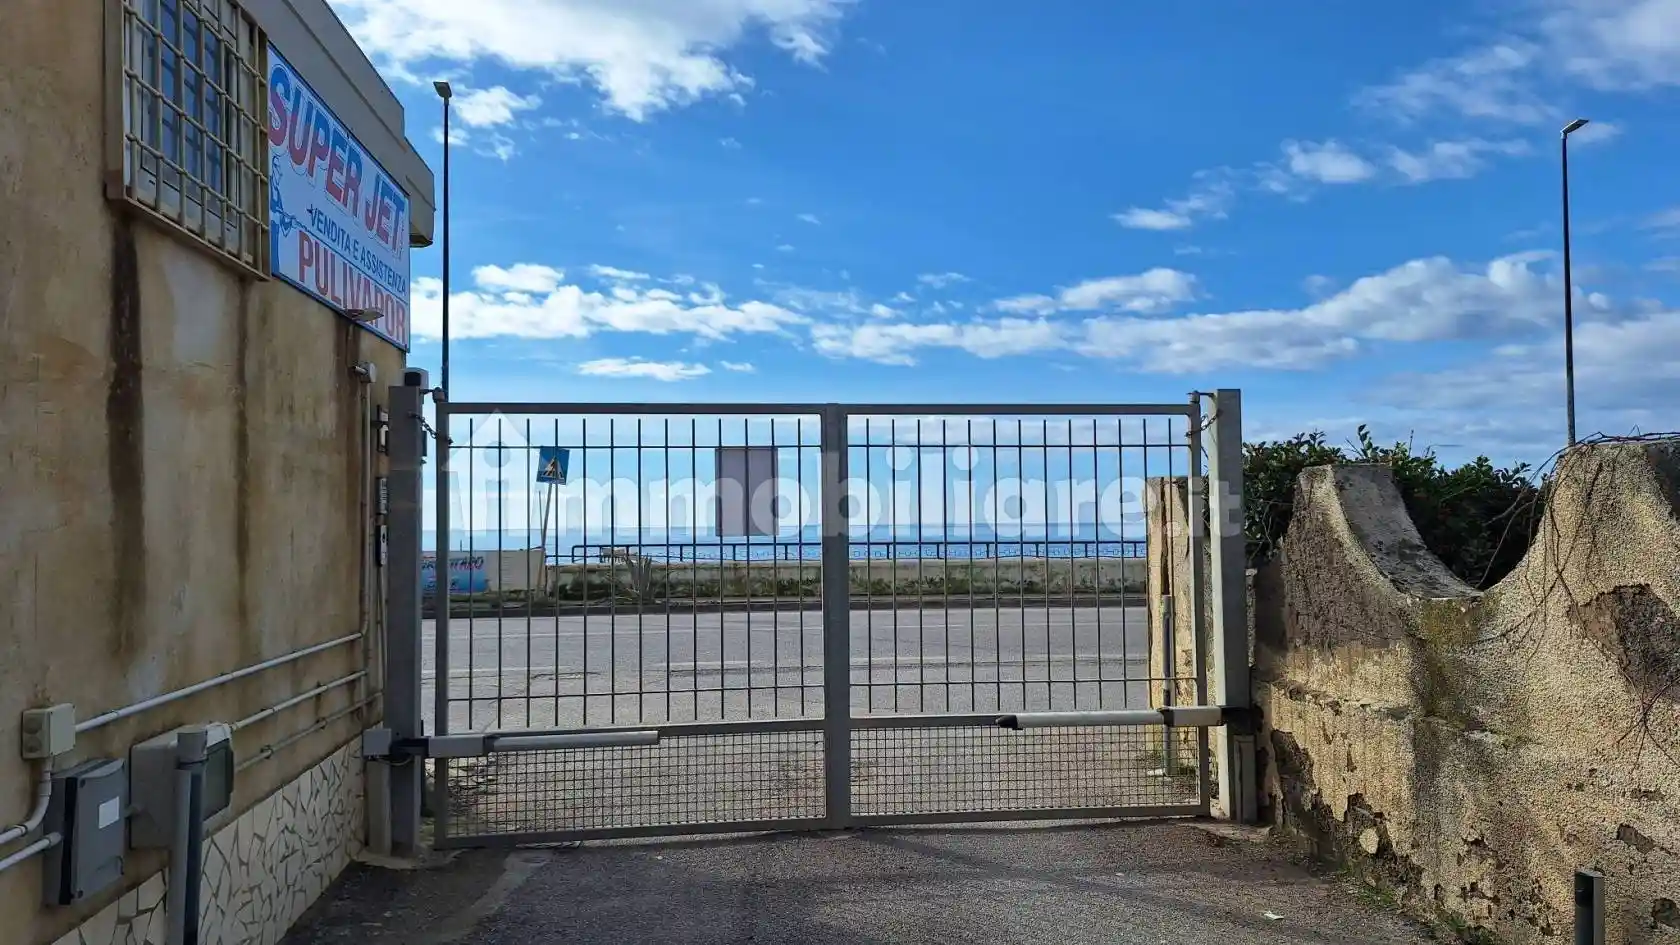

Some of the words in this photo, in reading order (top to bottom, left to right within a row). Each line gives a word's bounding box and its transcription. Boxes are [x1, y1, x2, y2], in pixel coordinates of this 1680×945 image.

[268, 66, 362, 218] SUPER
[364, 173, 404, 252] JET
[298, 229, 406, 346] PULIVAPOR
[312, 208, 351, 254] VENDITA
[351, 240, 360, 261] E
[361, 247, 407, 296] ASSISTENZA
